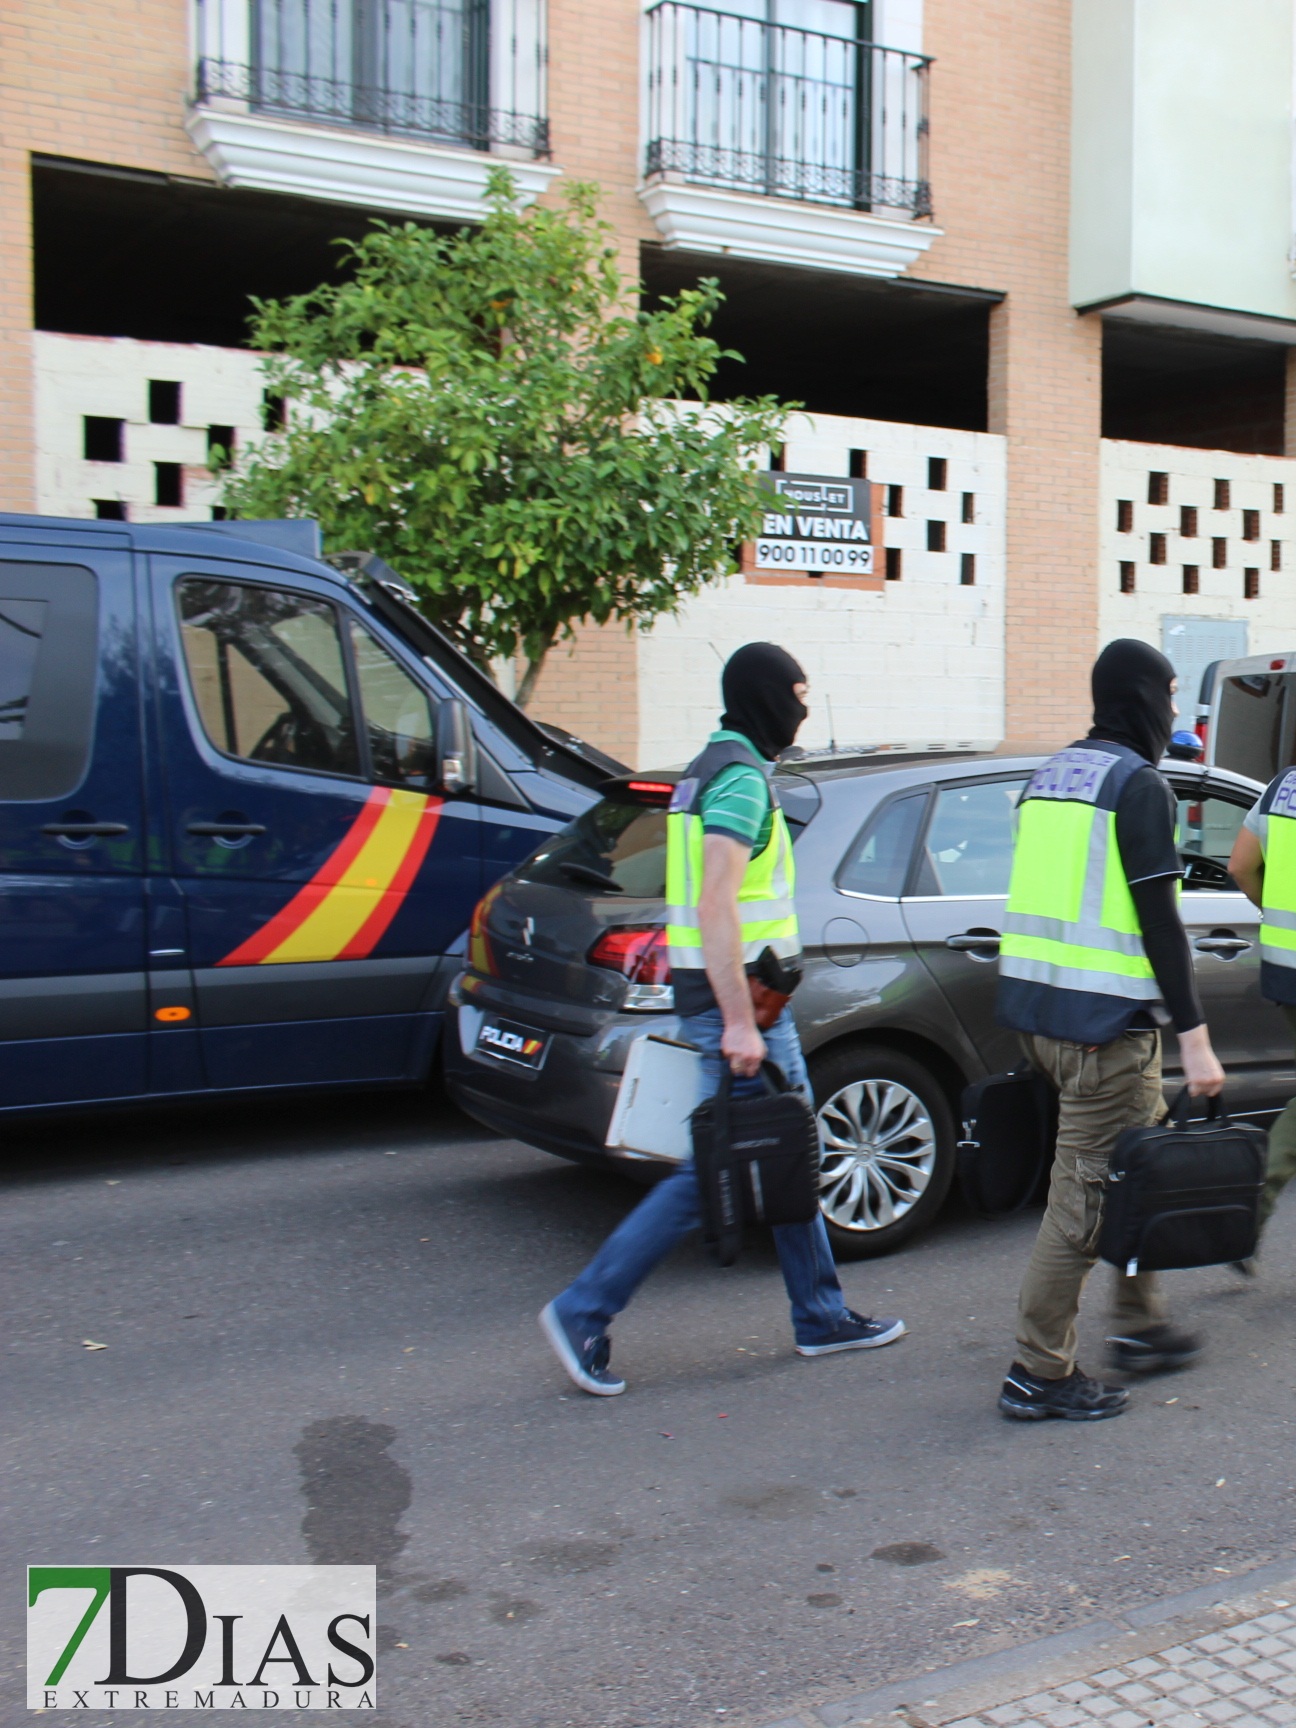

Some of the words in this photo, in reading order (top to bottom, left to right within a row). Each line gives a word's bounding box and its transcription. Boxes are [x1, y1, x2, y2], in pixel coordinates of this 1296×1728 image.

[763, 513, 793, 536] EN
[796, 516, 869, 541] VENTA
[759, 544, 795, 563] 900
[800, 546, 815, 564] 11
[821, 548, 844, 566] 00
[847, 550, 870, 568] 99
[479, 1025, 524, 1053] POLICIA
